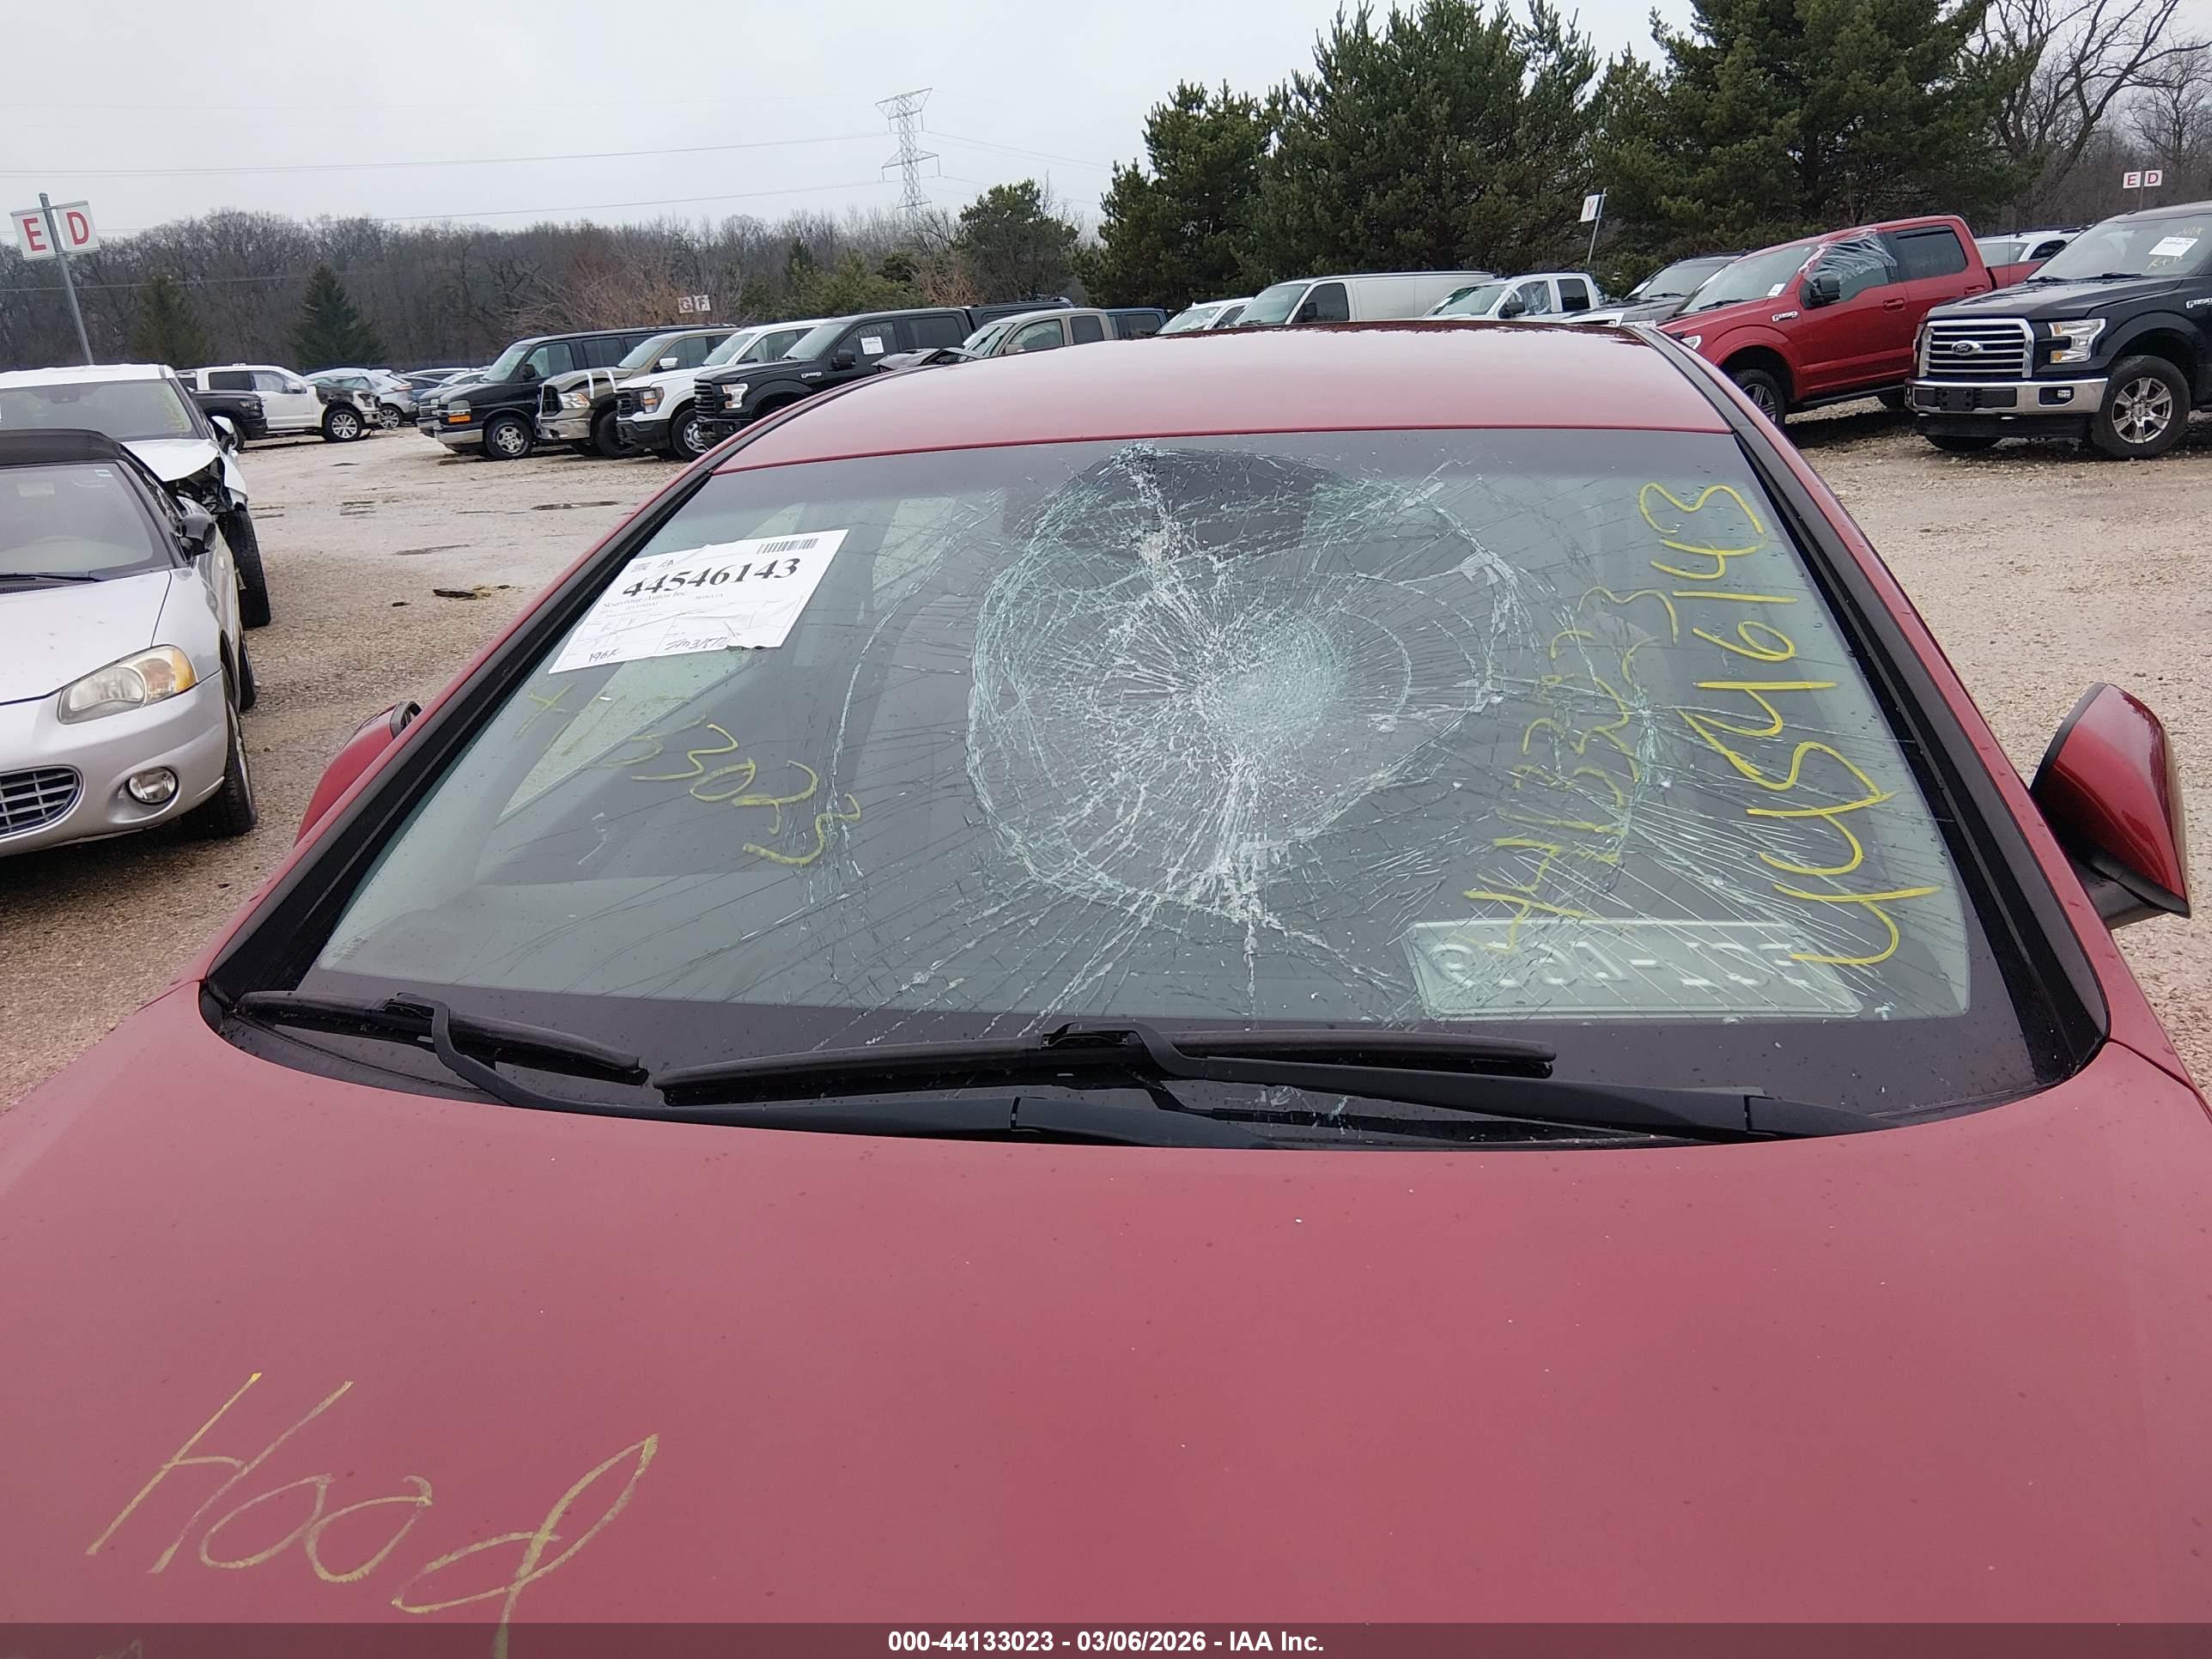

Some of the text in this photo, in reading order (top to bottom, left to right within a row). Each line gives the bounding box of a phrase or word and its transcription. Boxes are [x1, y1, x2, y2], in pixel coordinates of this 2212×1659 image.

[2127, 173, 2159, 186] E D
[22, 211, 89, 252] E D
[623, 557, 801, 597] 44546143
[1638, 481, 1943, 967] 44546143
